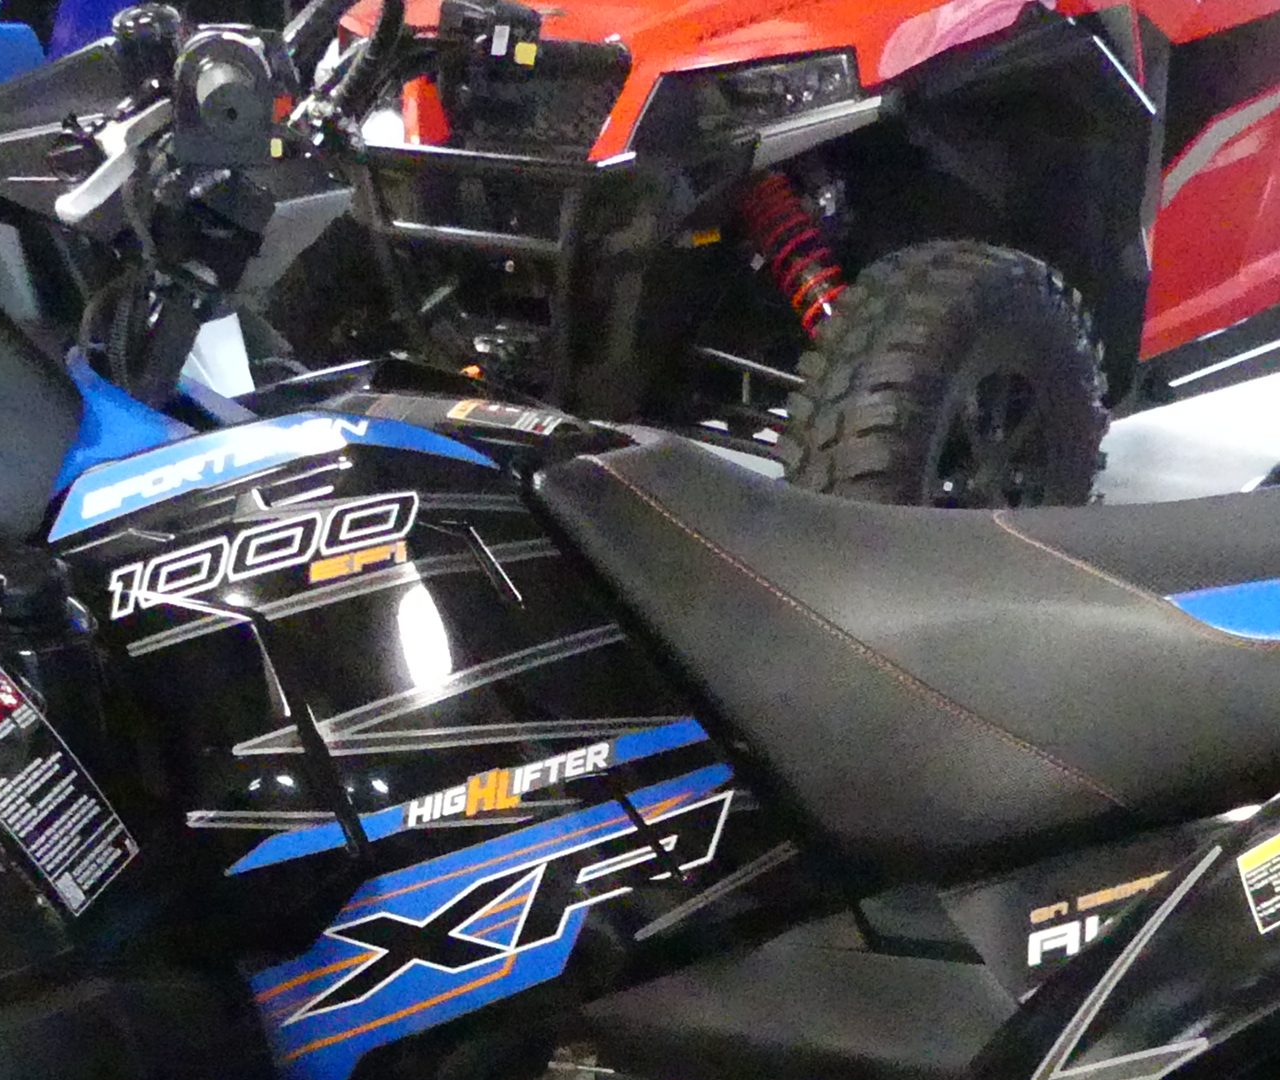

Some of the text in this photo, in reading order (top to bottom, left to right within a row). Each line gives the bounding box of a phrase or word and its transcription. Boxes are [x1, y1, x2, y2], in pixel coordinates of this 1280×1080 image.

[82, 418, 368, 519] SPORTAN
[110, 492, 418, 620] 1000
[310, 541, 407, 582] EFI
[280, 790, 734, 1026] XP
